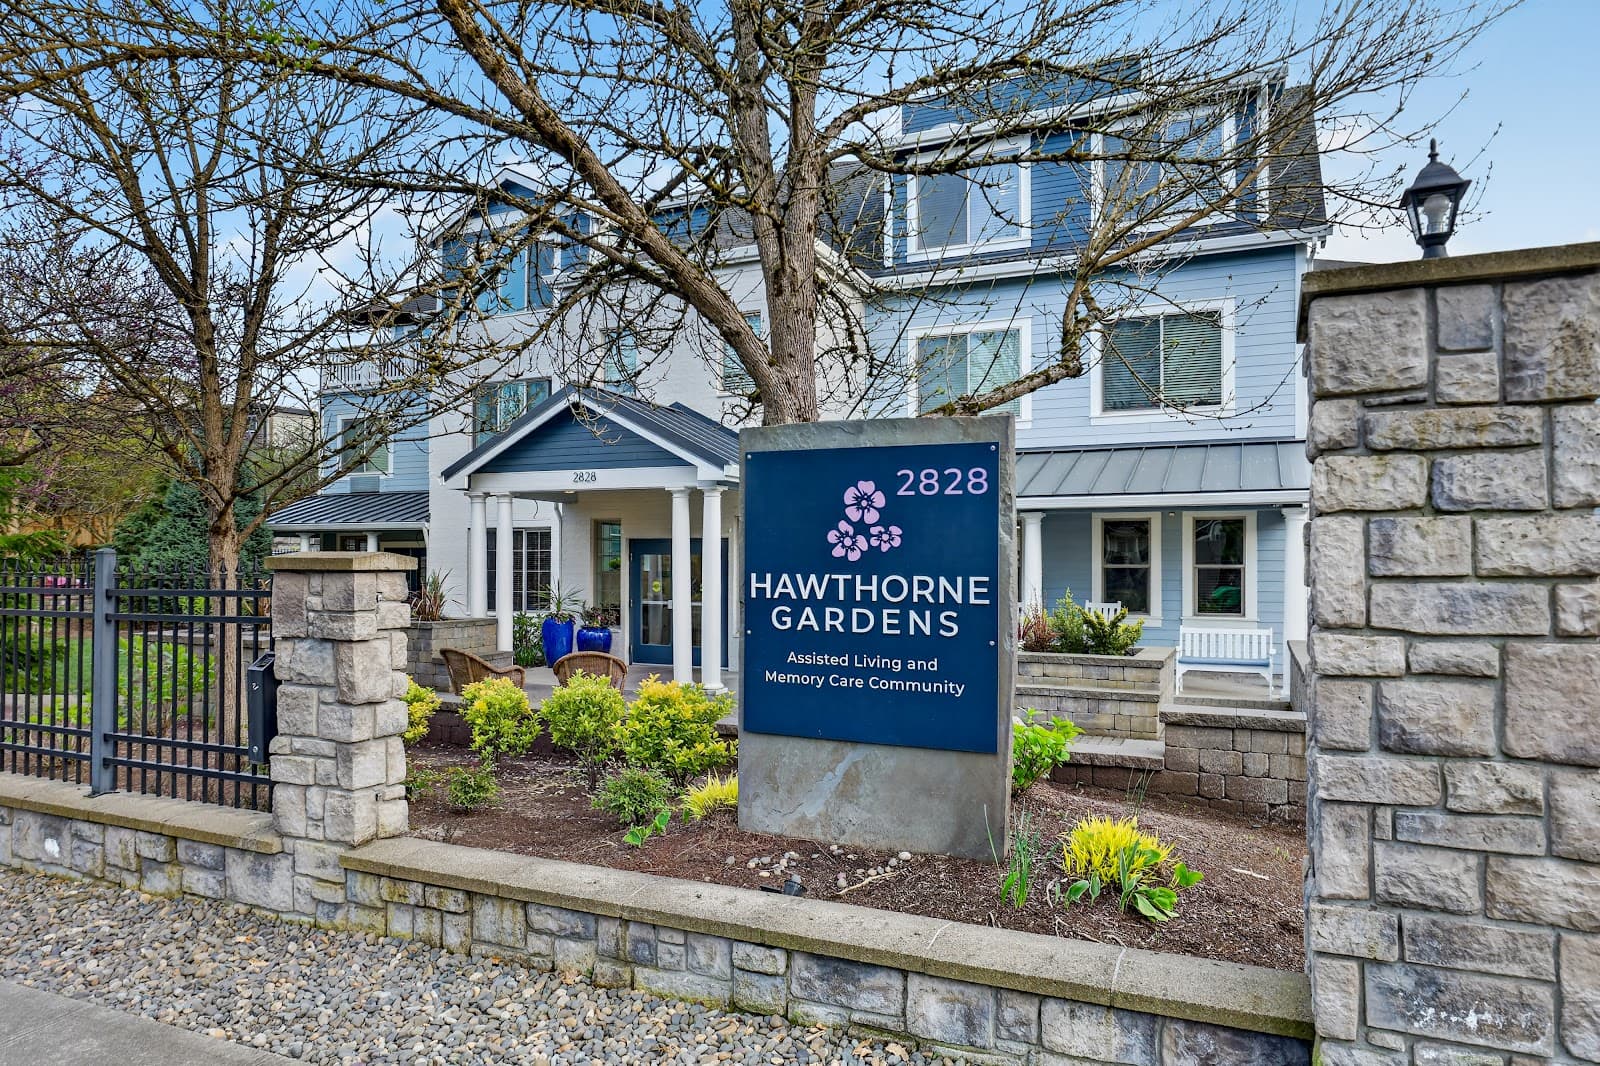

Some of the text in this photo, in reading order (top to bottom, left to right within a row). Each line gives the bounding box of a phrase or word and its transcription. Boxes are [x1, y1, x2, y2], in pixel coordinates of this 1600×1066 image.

[573, 471, 597, 483] 2828
[896, 467, 989, 496] 2828
[750, 572, 991, 605] HAWTHORNE
[771, 606, 960, 637] GARDENS
[787, 651, 938, 672] Assisted Living and
[765, 670, 966, 697] Memory Care Community
